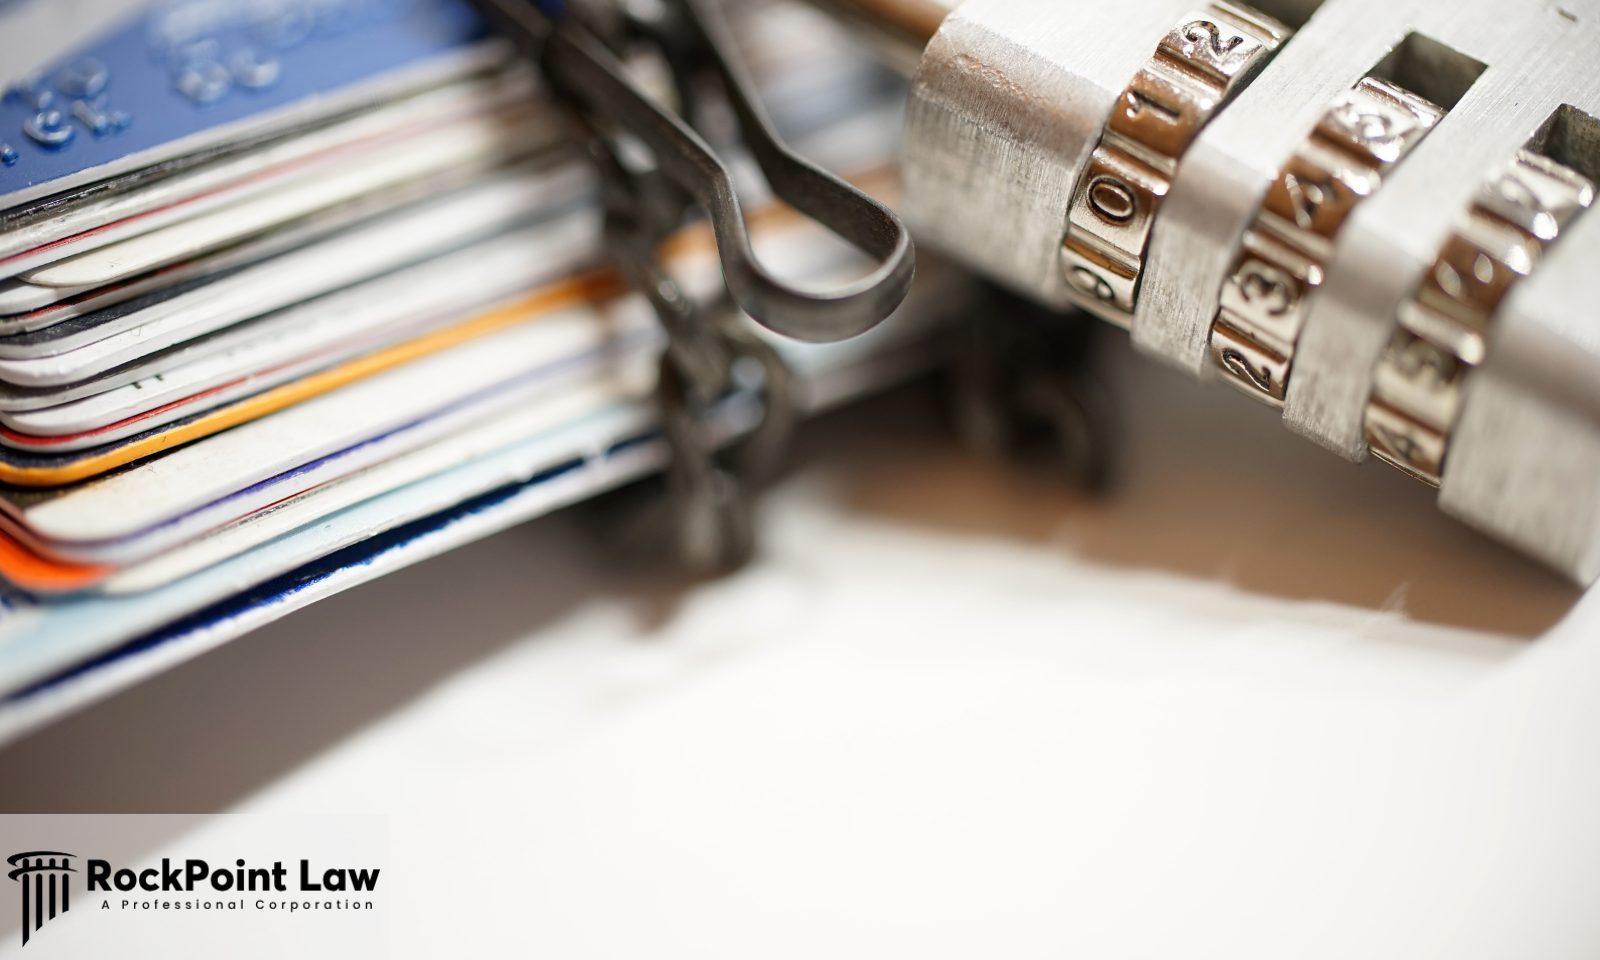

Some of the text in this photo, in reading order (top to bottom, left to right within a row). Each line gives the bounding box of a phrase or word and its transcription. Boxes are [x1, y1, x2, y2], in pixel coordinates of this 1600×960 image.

[1086, 174, 1137, 227] 0
[1126, 88, 1182, 121] 1
[1181, 19, 1245, 58] 2
[1239, 266, 1298, 317] 3
[1220, 347, 1272, 393] 2
